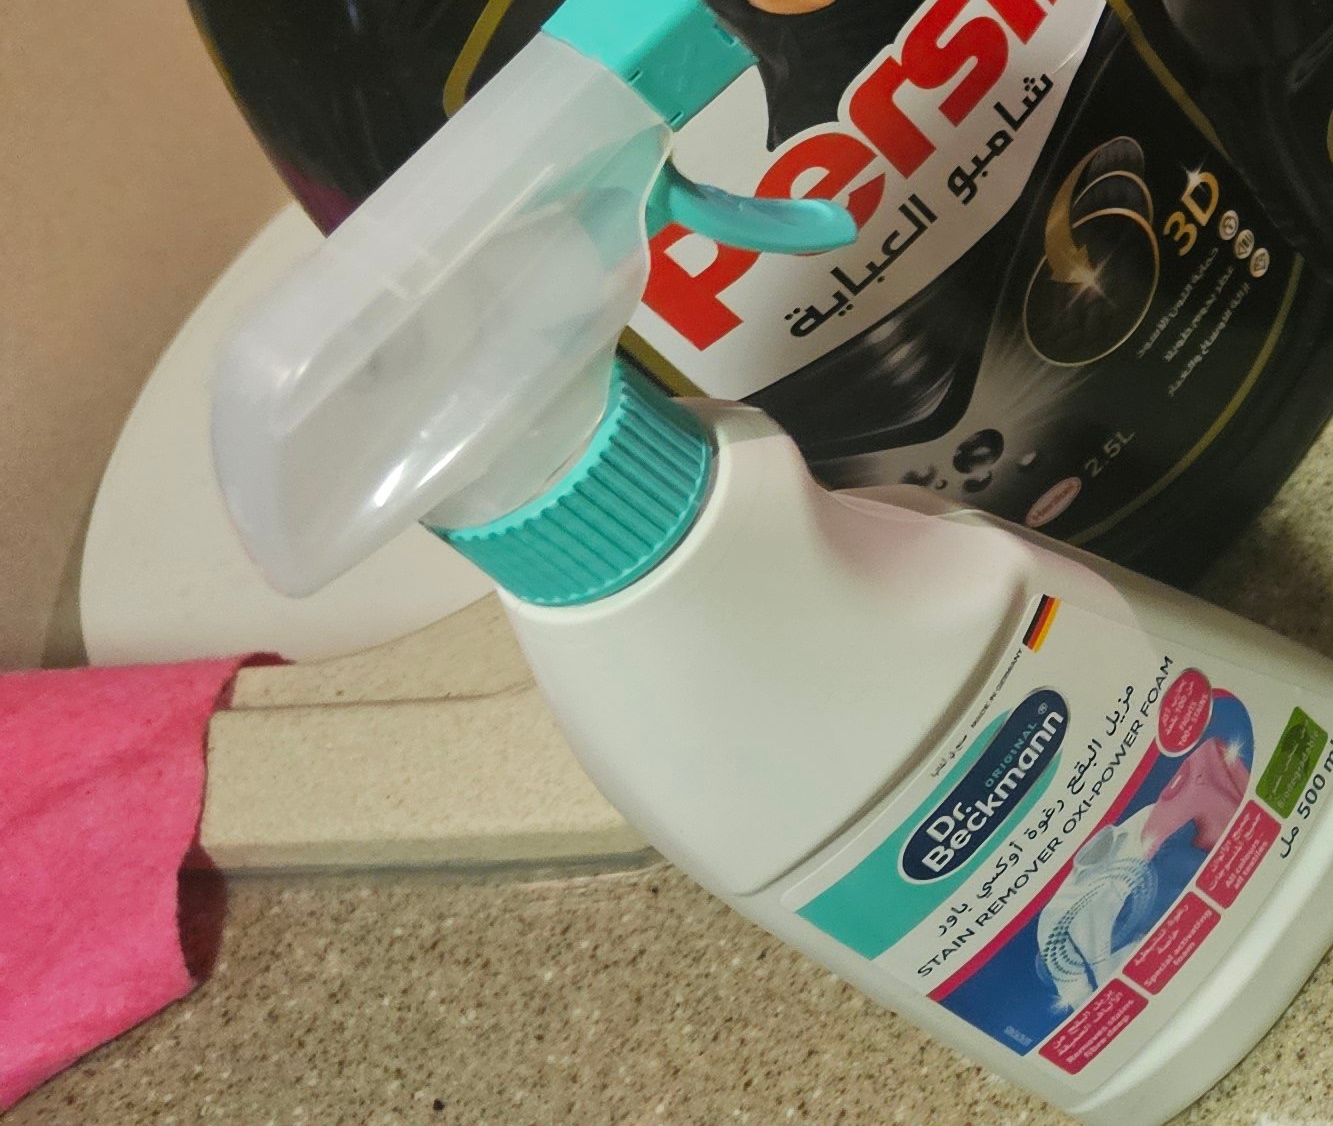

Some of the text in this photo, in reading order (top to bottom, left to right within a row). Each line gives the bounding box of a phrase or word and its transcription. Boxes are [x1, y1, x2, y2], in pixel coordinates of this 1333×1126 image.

[786, 74, 1054, 338] شامبو العباية
[1164, 172, 1219, 257] 3D
[1084, 431, 1136, 478] 2.5L
[922, 711, 1064, 873] Beckmann
[985, 722, 1037, 788] ORIGINAL
[917, 655, 1174, 977] STAIN REMOVER OXI-POWER FOAM
[926, 801, 973, 843] Dr.
[938, 685, 1134, 937] مزيل البقع رغوة أوكسي باور
[1297, 773, 1326, 820] 500
[1280, 826, 1300, 859] مل
[1143, 909, 1213, 987] Special activating
